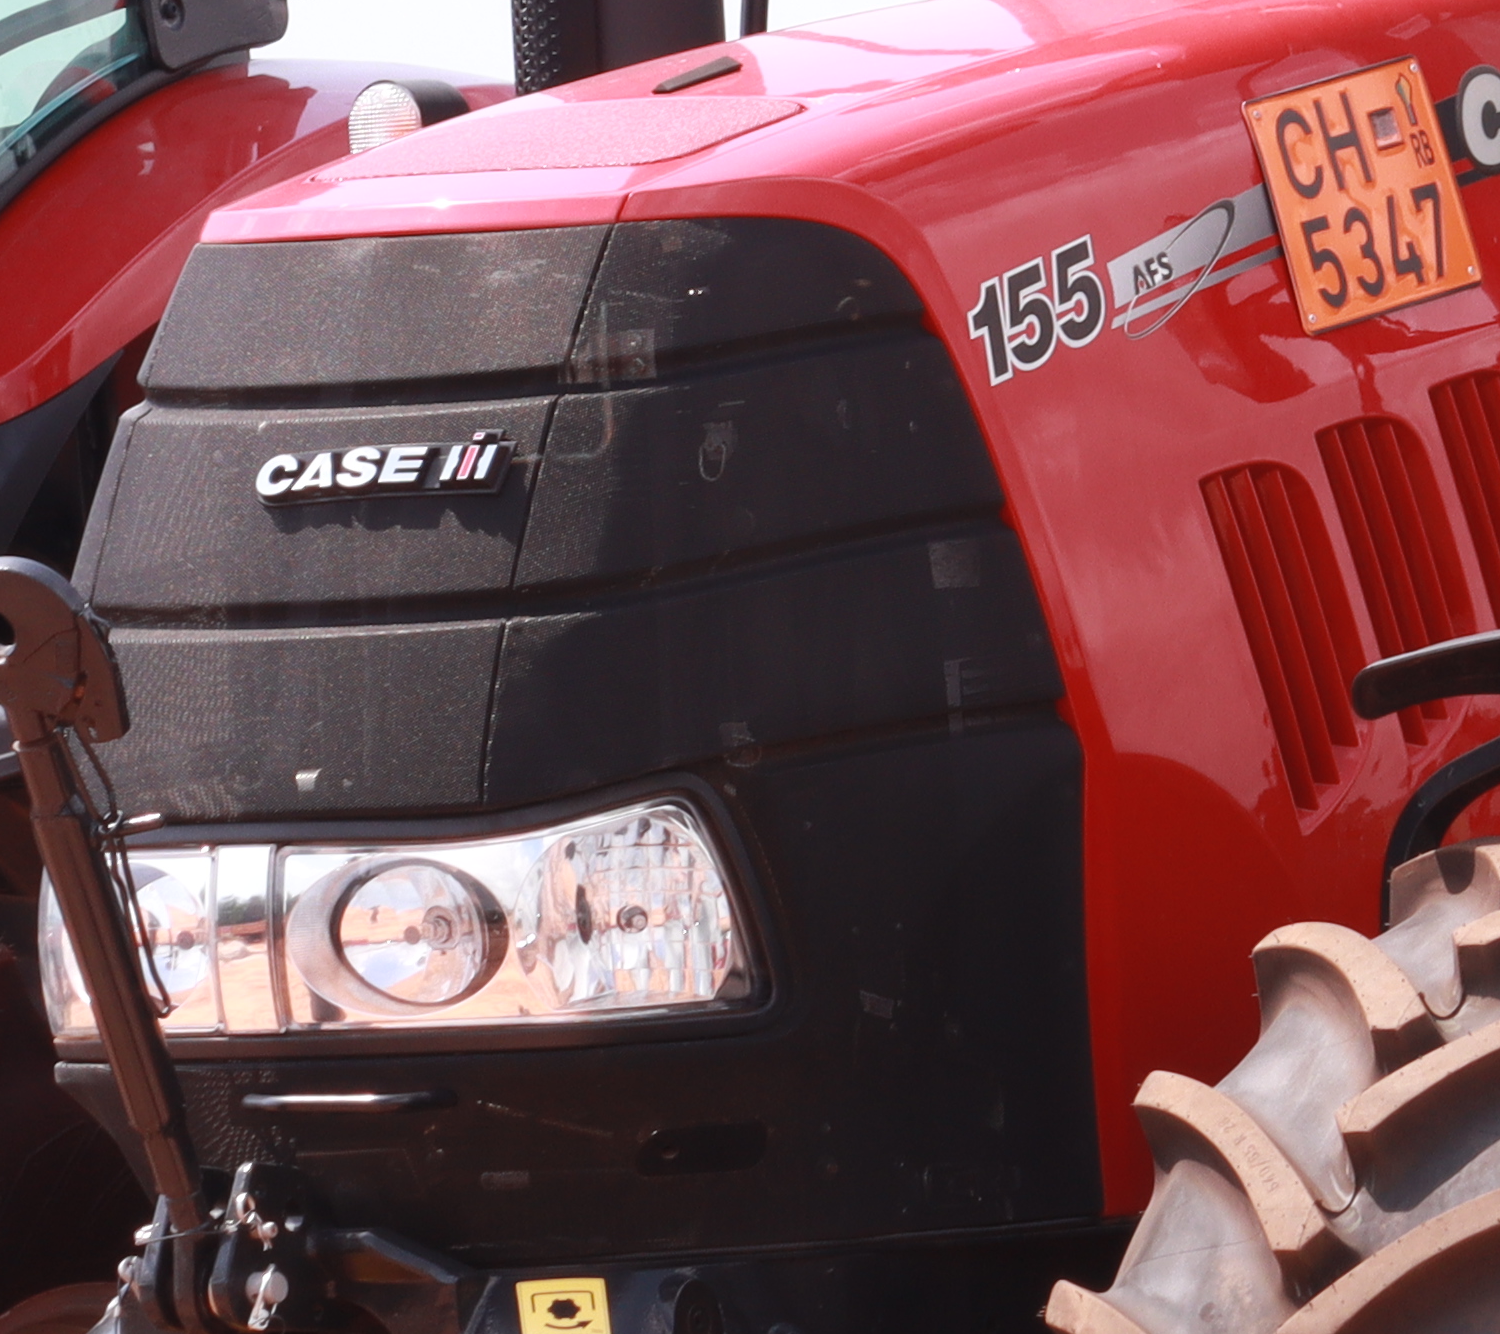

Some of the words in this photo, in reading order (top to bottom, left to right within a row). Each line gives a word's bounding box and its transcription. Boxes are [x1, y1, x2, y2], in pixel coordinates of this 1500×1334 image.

[1274, 91, 1376, 201] CH
[1408, 131, 1437, 169] RB
[1300, 181, 1447, 311] 5347
[967, 234, 1105, 387] 155
[1131, 250, 1174, 297] AFS
[255, 445, 429, 496] CASE
